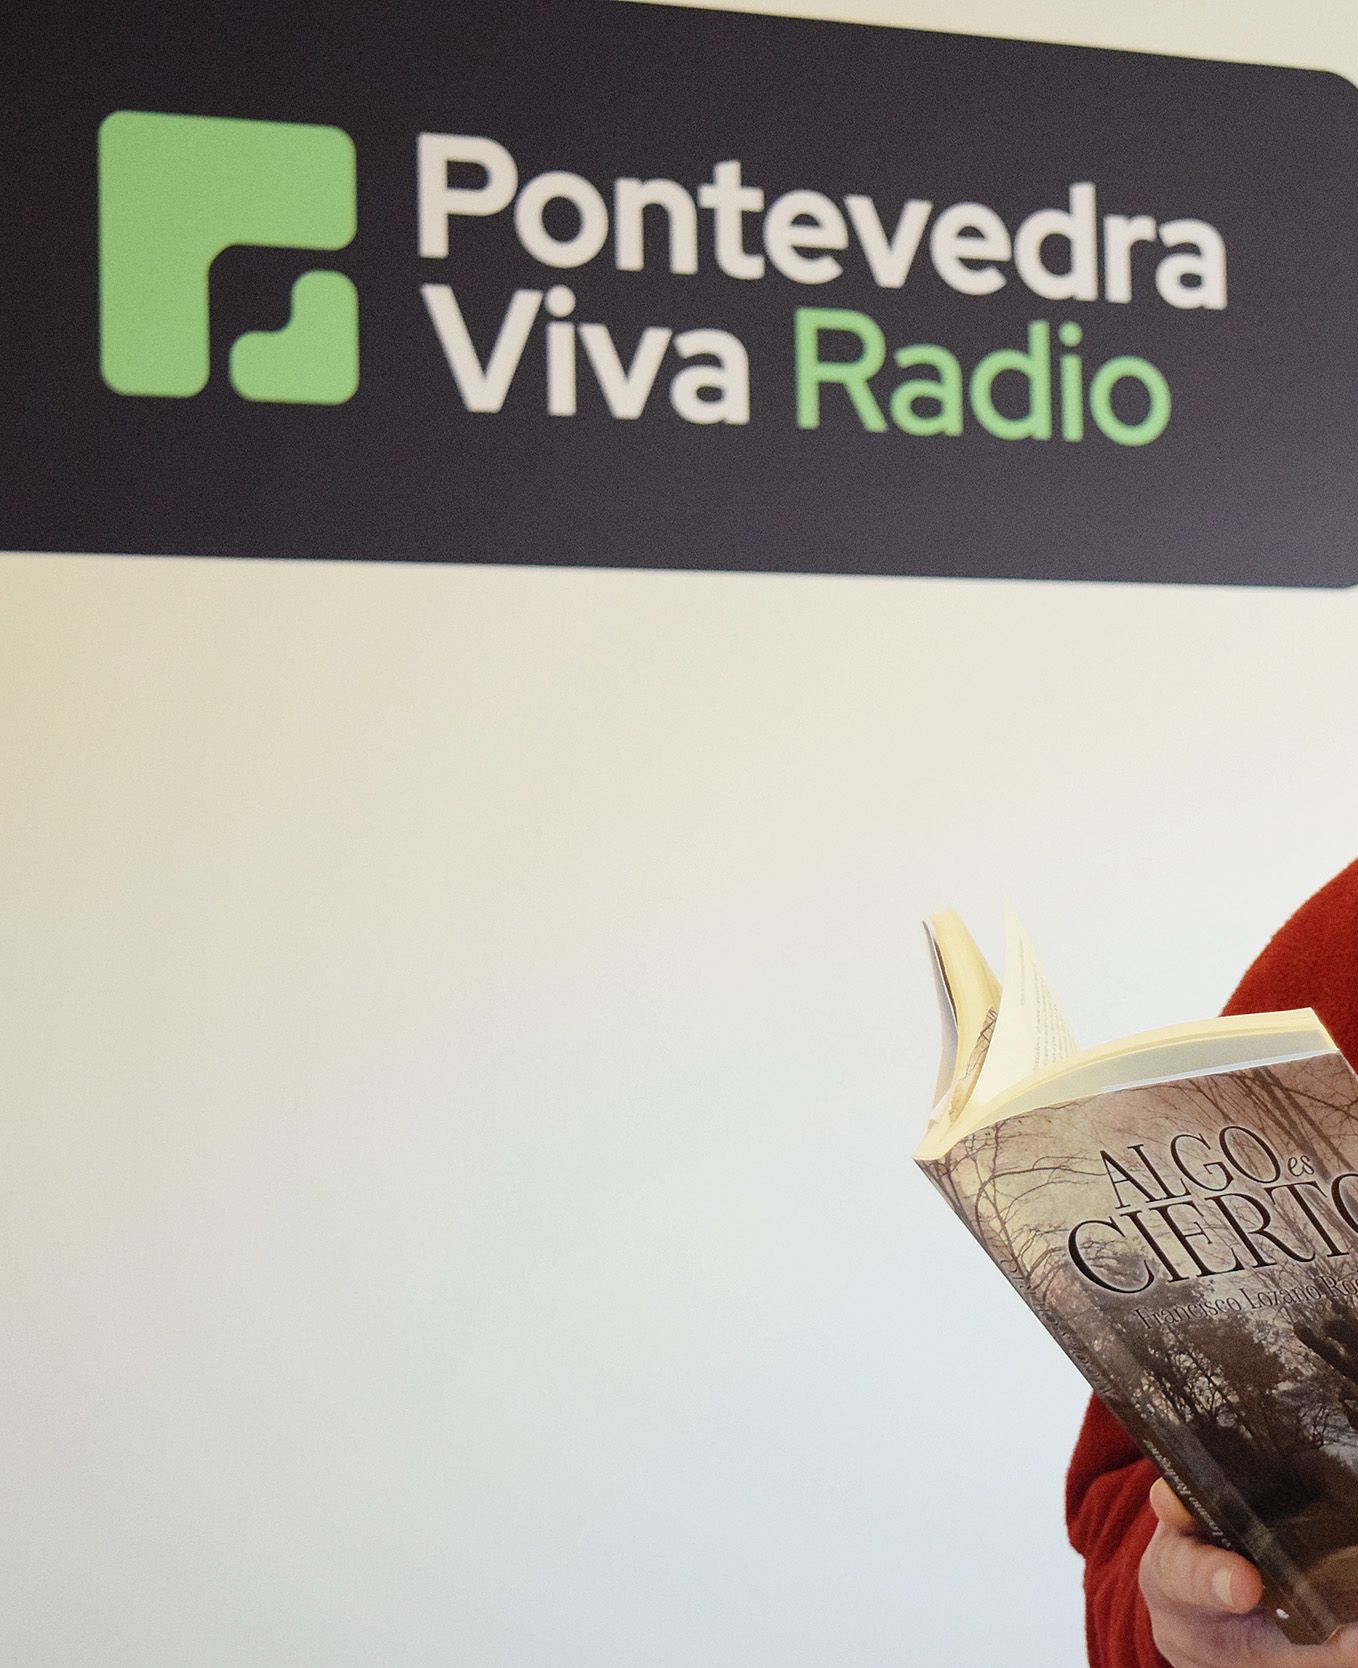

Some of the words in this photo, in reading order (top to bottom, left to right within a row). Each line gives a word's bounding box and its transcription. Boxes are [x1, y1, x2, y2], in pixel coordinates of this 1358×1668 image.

[416, 132, 1228, 310] Pontevedra
[420, 284, 750, 425] Viva
[795, 307, 1172, 446] Radio
[1100, 1126, 1281, 1209] ALGO
[1287, 1154, 1315, 1177] es
[1134, 1295, 1242, 1330] Francisco
[1240, 1285, 1322, 1310] Lozano
